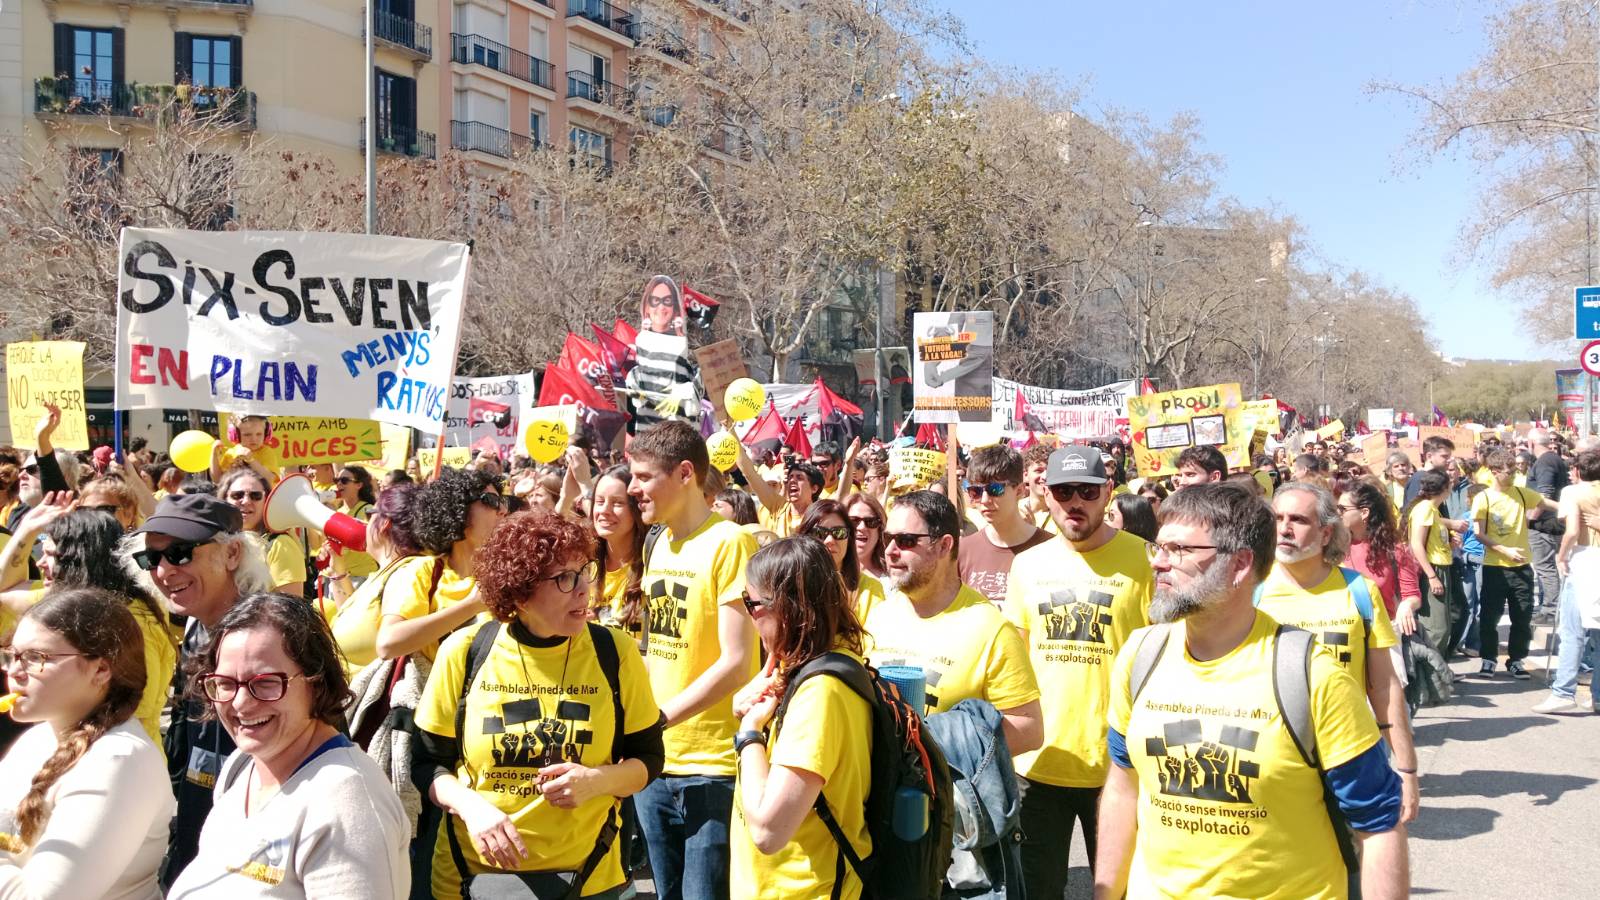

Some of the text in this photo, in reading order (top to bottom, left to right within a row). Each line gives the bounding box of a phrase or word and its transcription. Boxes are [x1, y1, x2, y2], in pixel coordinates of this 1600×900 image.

[40, 347, 52, 364] LA
[341, 331, 431, 378] MENYS
[924, 344, 952, 353] TOTHOM
[130, 344, 318, 403] EN PLAN
[10, 374, 29, 410] NO
[60, 389, 82, 412] SER
[1161, 389, 1219, 413] PROU!
[318, 418, 348, 430] AMB
[472, 407, 505, 423] CGT
[1055, 653, 1101, 665] explotació
[480, 681, 599, 695] Assemblea Pineda de Mar
[1145, 700, 1193, 714] Assemblea
[1195, 703, 1231, 717] Pineda
[1250, 708, 1273, 720] Mar
[493, 780, 506, 793] és
[1150, 793, 1268, 819] Vocació sense inversió
[1160, 812, 1251, 836] és explotació
